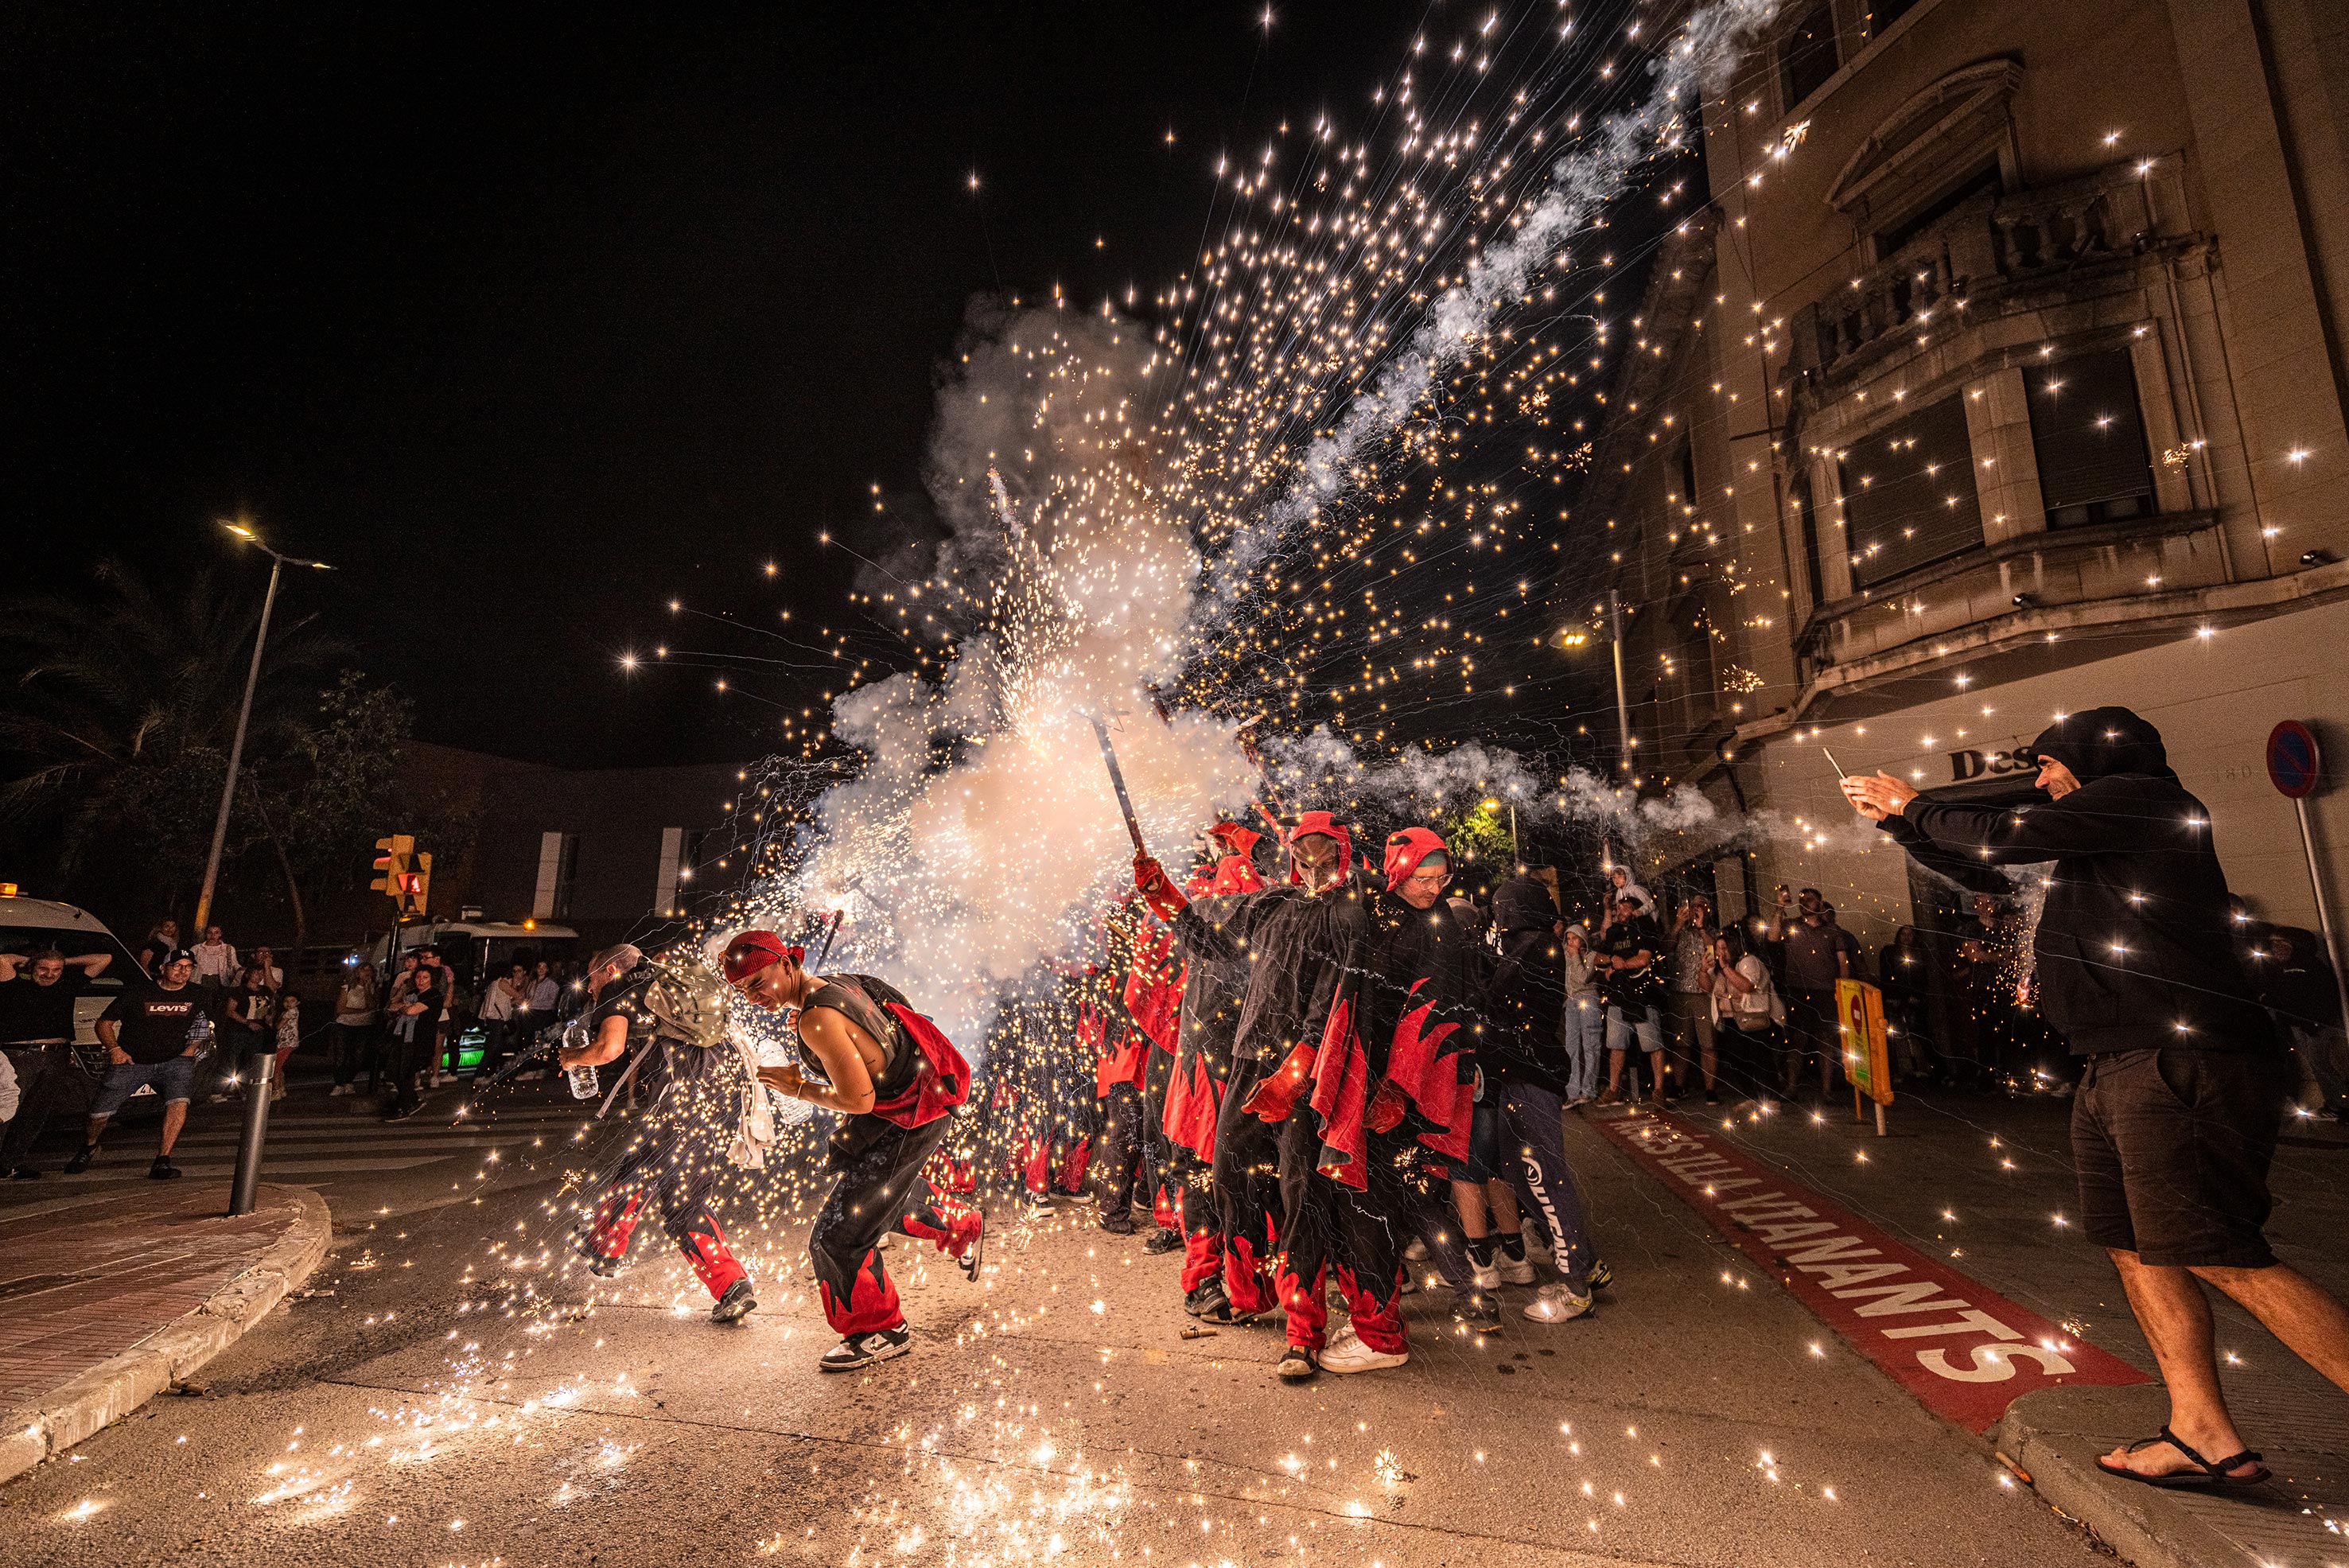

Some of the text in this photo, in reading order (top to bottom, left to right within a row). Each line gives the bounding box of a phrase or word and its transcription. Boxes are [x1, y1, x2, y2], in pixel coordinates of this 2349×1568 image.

[1948, 746, 2035, 781] Des
[1657, 1152, 1763, 1192] ILLA
[1717, 1192, 2077, 1383] VIANANTS
